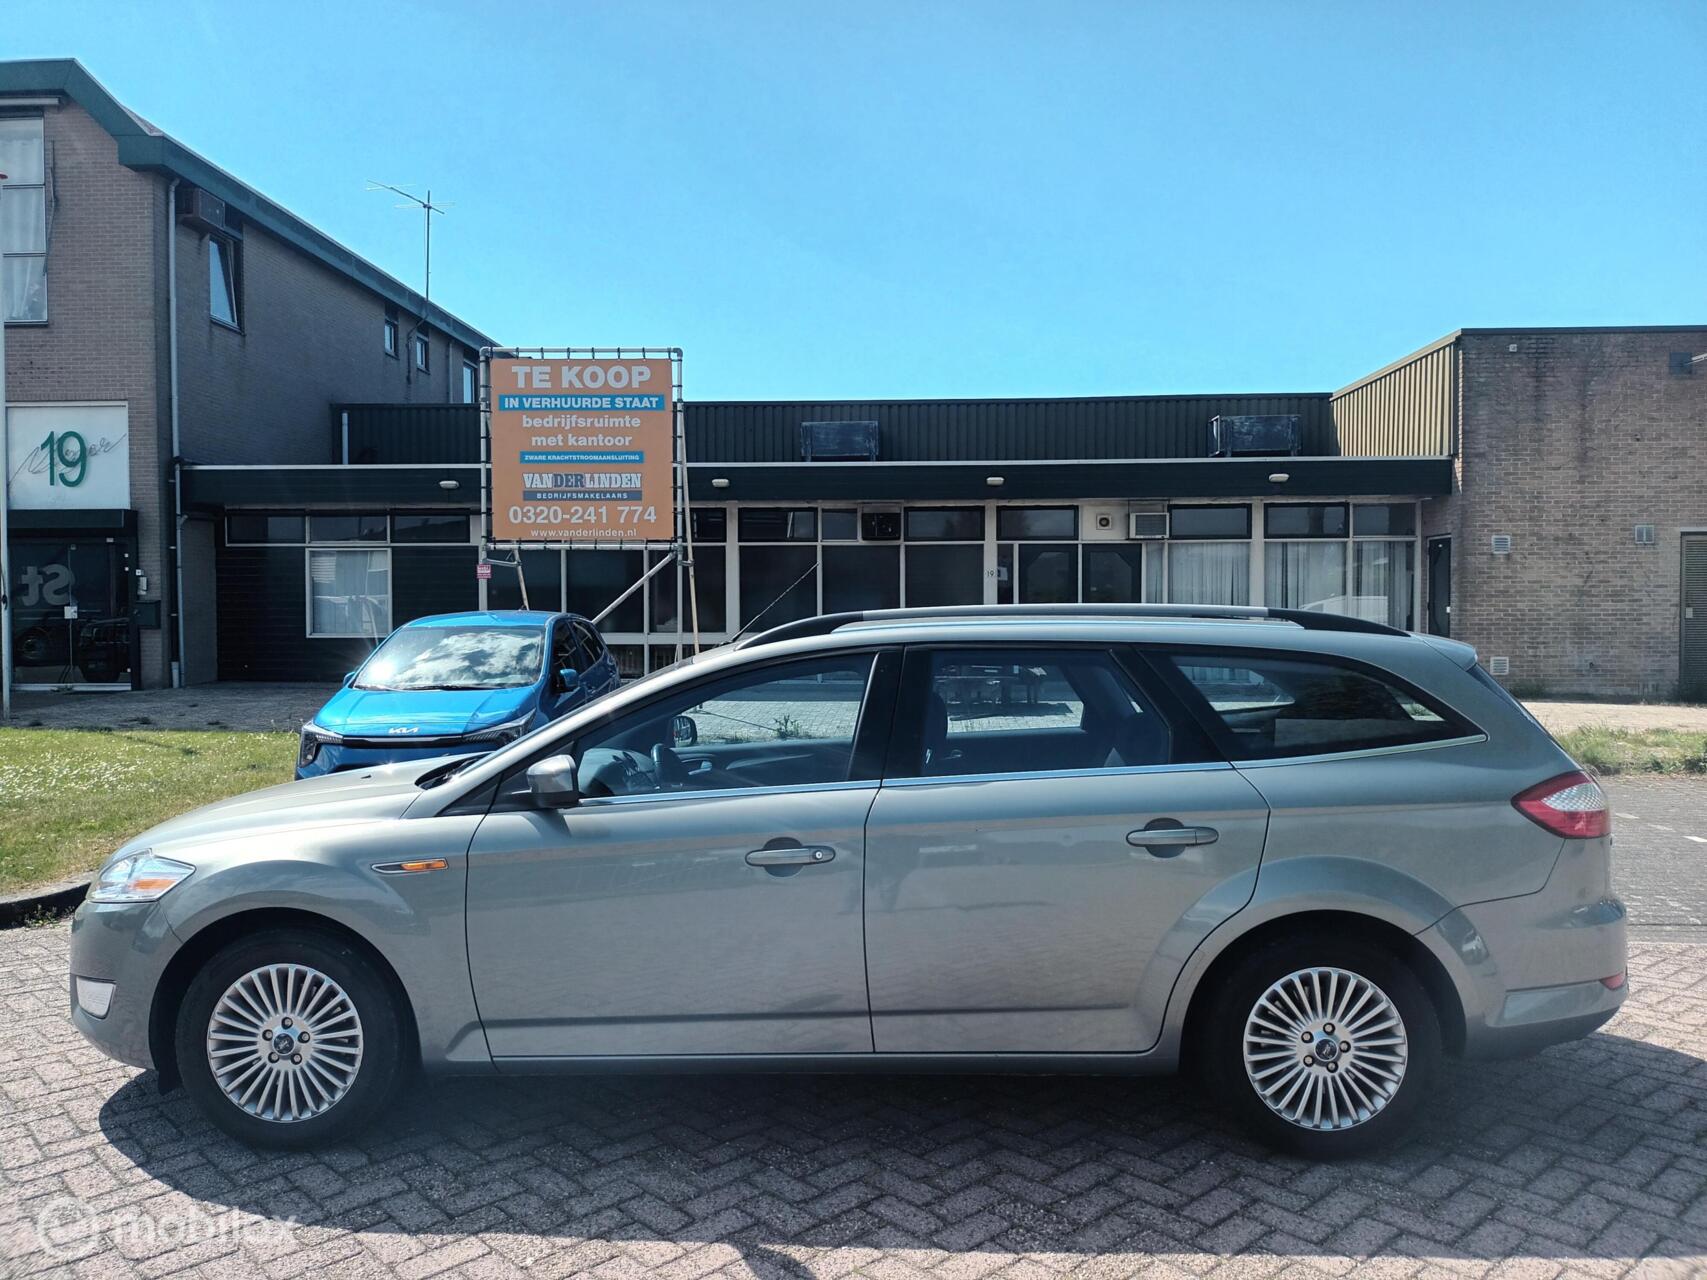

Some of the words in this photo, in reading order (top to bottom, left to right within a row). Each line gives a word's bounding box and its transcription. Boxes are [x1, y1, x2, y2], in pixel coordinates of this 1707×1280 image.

[511, 366, 551, 389] TE
[561, 365, 651, 389] KOOP
[504, 397, 519, 408] IN
[522, 397, 611, 408] VERHUURDE
[614, 397, 659, 408] STAAT
[522, 415, 641, 430] bedrijfsruimte
[531, 435, 563, 446] met
[567, 433, 633, 446] kantoor
[40, 431, 88, 487] 19
[508, 506, 608, 524] 0320-241
[617, 506, 657, 524] 774
[530, 527, 637, 537] www.vanderlinden.nl
